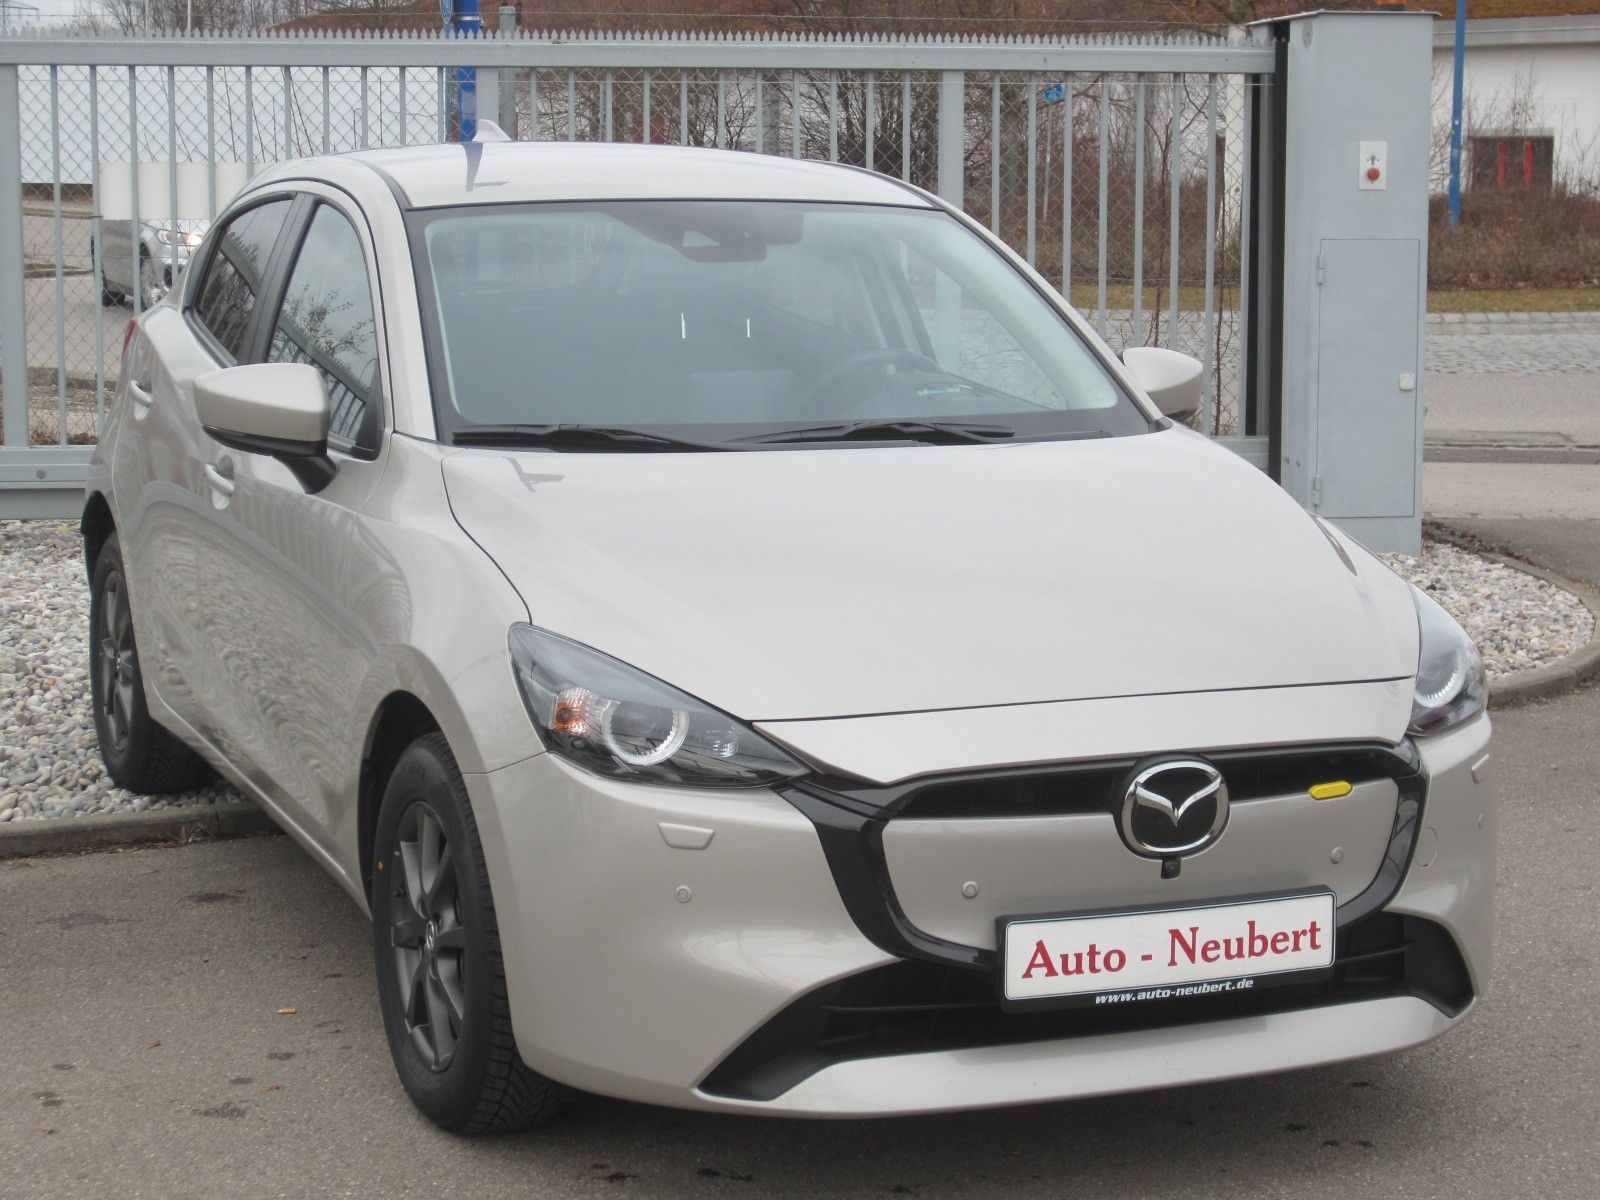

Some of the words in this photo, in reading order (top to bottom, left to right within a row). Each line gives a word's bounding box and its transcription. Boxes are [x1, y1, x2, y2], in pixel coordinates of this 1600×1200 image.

[1021, 940, 1126, 979] Auto
[1167, 920, 1321, 967] Neubert
[1095, 978, 1253, 1004] www.auto-neubert.de
